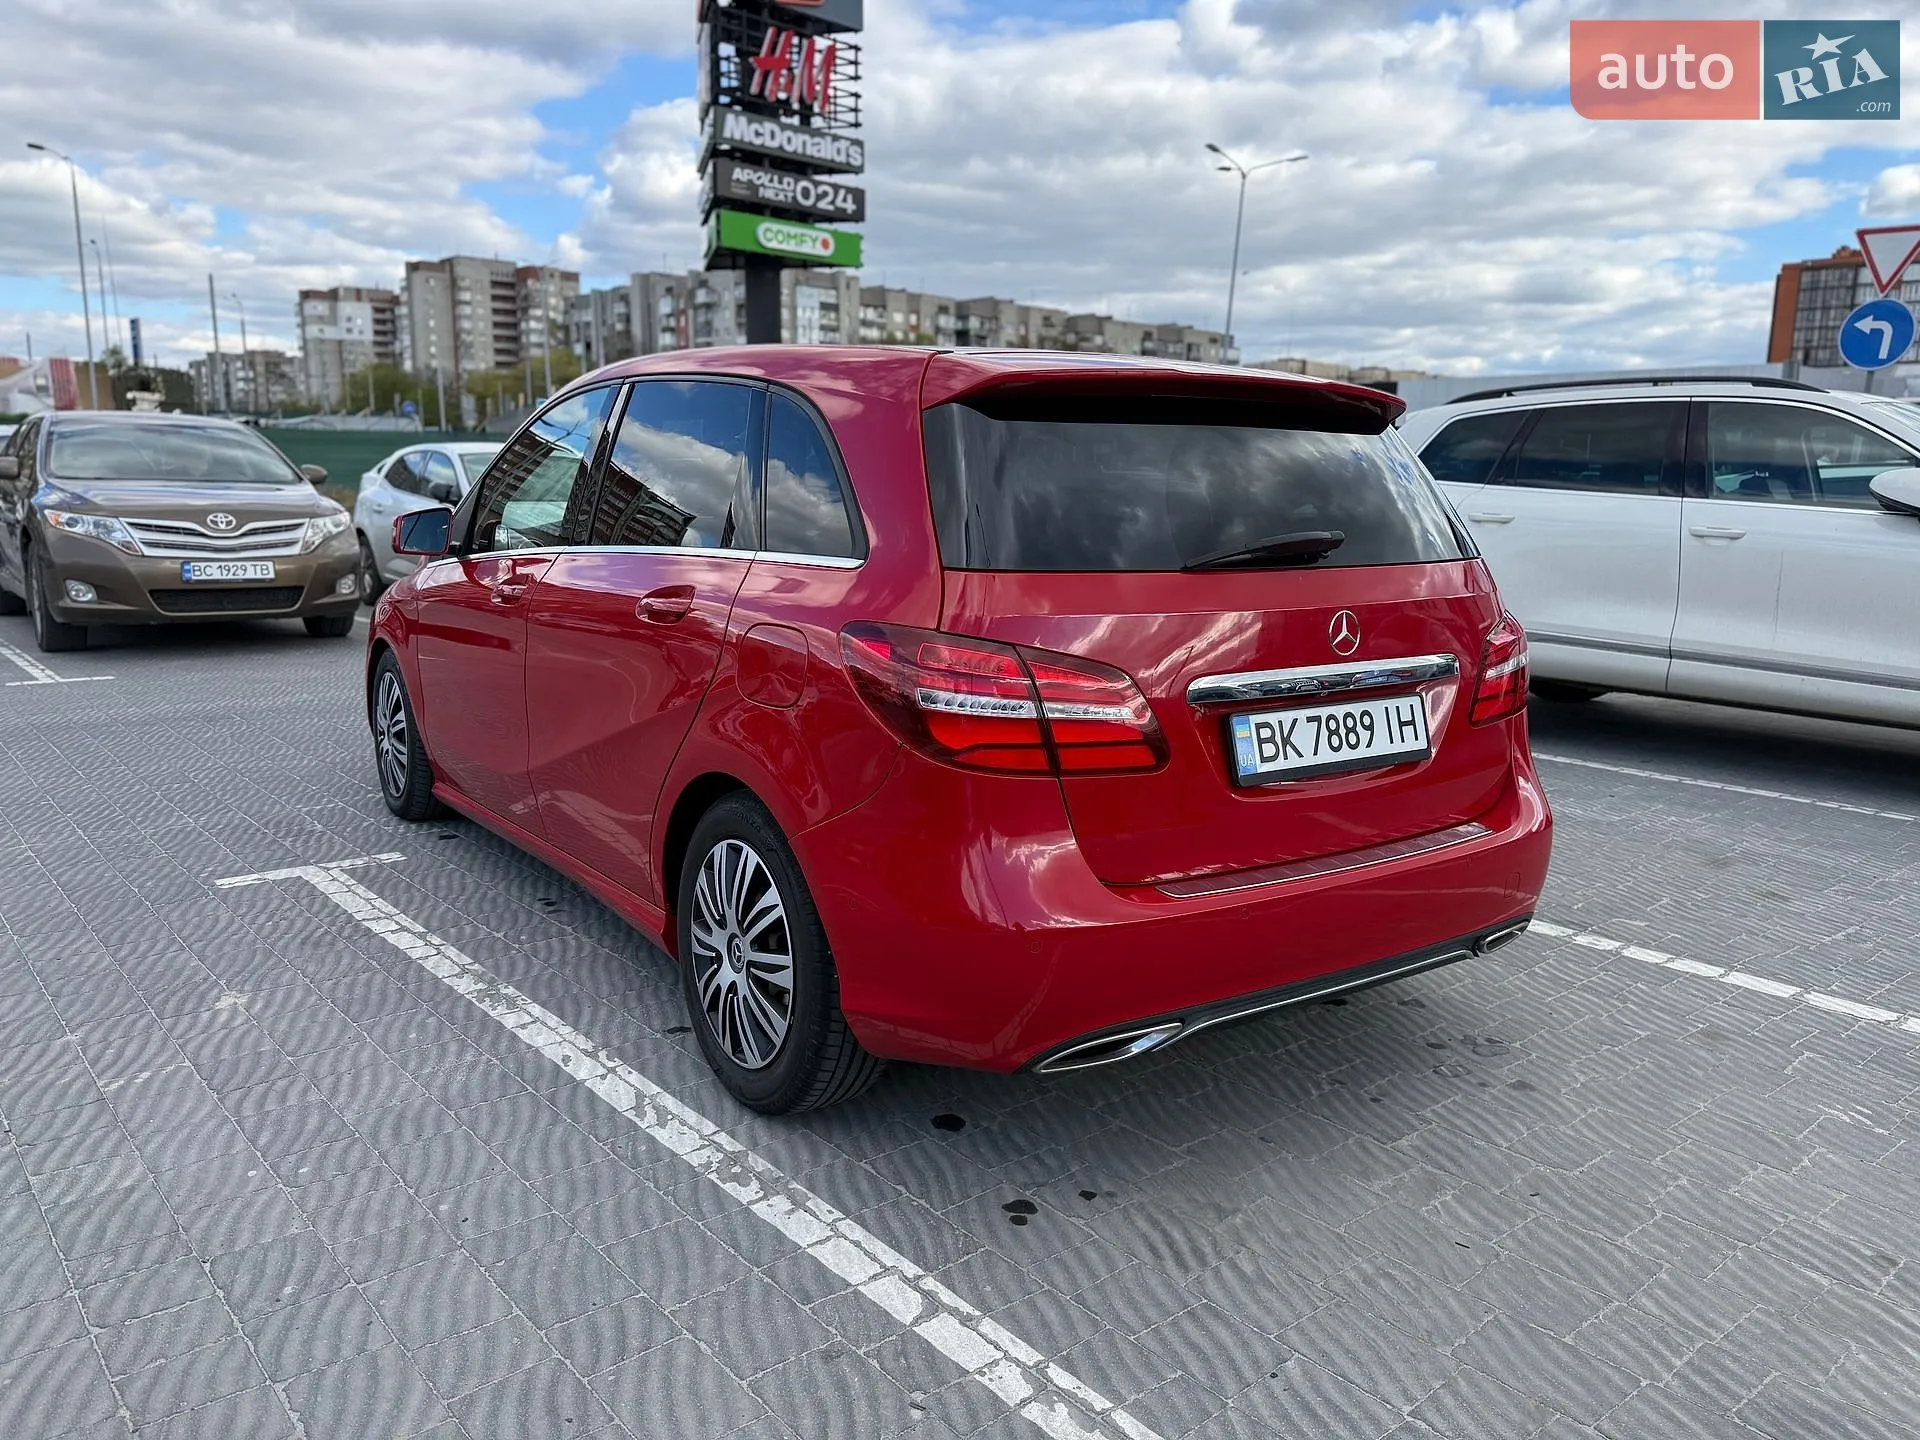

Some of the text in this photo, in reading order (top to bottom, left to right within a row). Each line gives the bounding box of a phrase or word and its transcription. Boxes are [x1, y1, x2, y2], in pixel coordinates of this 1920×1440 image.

[749, 25, 837, 114] H&M
[722, 113, 863, 167] McDonald's
[732, 167, 795, 191] APOLLO
[758, 186, 796, 203] NEXT
[762, 226, 820, 248] COMFY
[192, 564, 214, 577] BC
[216, 564, 248, 577] 1929
[250, 563, 271, 576] TB
[1254, 703, 1419, 764] BK 7889 IH
[1240, 753, 1255, 767] UA
